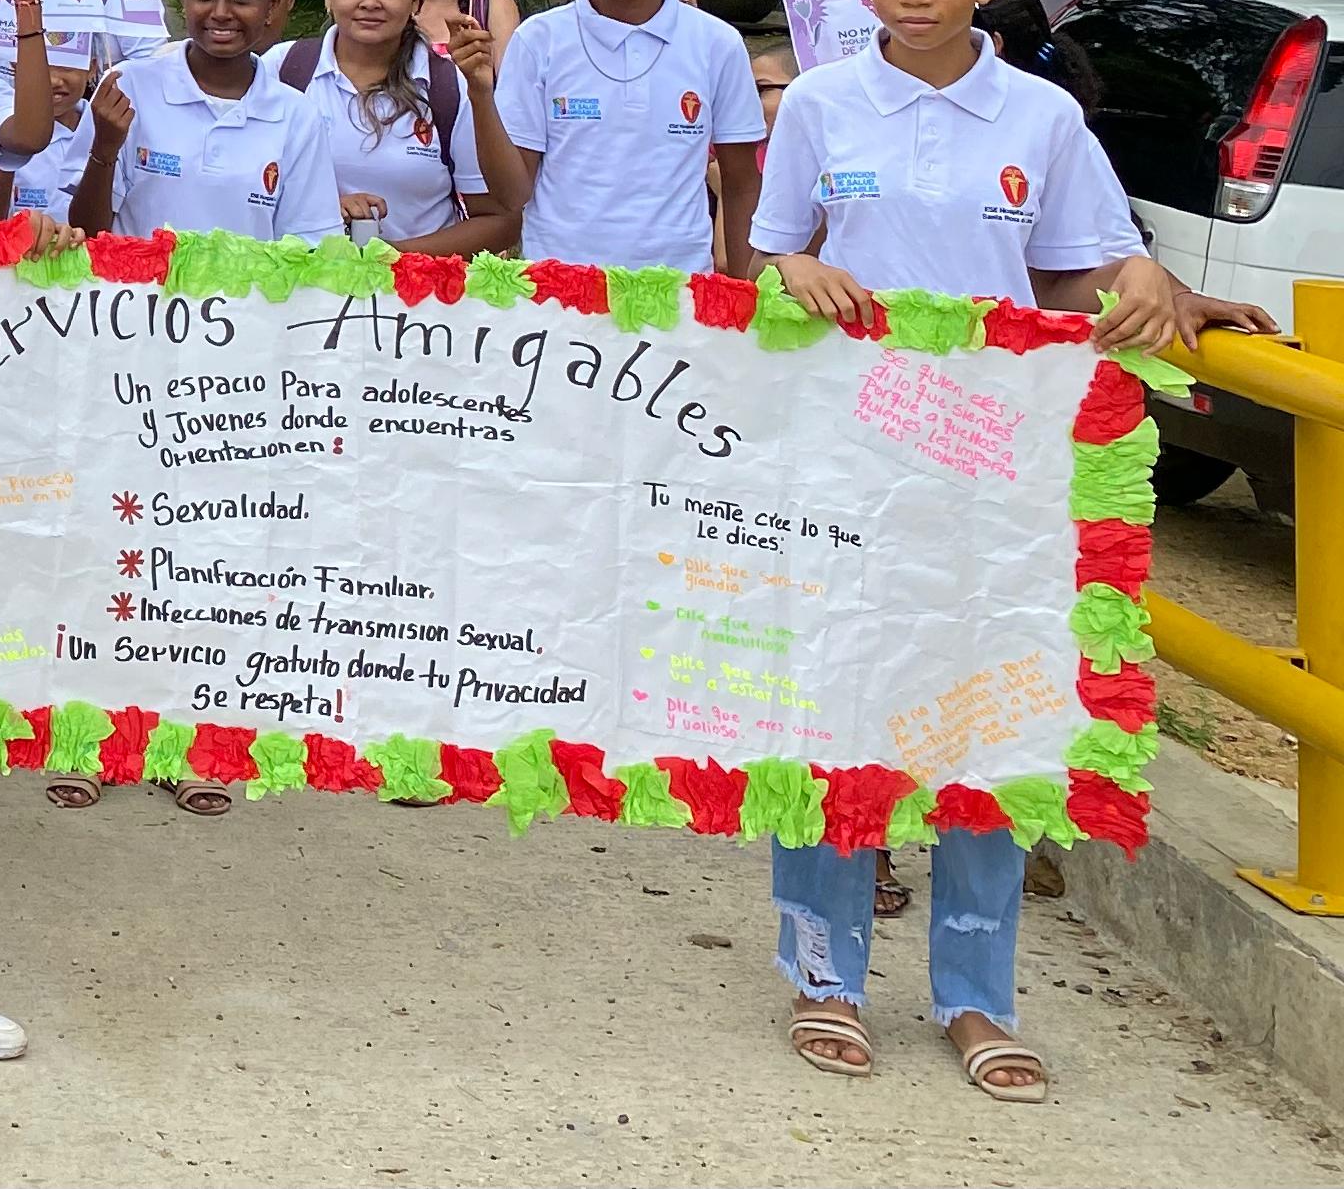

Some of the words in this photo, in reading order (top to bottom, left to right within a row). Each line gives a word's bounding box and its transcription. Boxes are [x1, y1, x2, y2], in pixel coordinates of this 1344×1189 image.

[838, 29, 858, 39] NO
[841, 45, 857, 56] DE
[113, 371, 153, 405] Un
[166, 374, 267, 404] espacio
[361, 378, 533, 424] adolescentes
[285, 294, 743, 459] Amigables
[280, 403, 349, 431] donde
[368, 414, 516, 443] encuentras
[151, 490, 310, 527] Sexualidad.
[642, 481, 670, 508] Tu
[754, 511, 792, 533] cree
[800, 517, 819, 538] lo
[828, 524, 863, 549] que
[726, 525, 785, 555] dices:
[150, 546, 307, 591] Planificación
[313, 565, 435, 600] Familiar.
[139, 597, 267, 627] Infecciones
[275, 601, 302, 631] de
[308, 601, 450, 642] transmision
[190, 683, 228, 711] Se
[234, 644, 340, 687] gratuito
[346, 648, 415, 682] donde
[418, 659, 451, 689] tu
[453, 667, 588, 708] Privacidad
